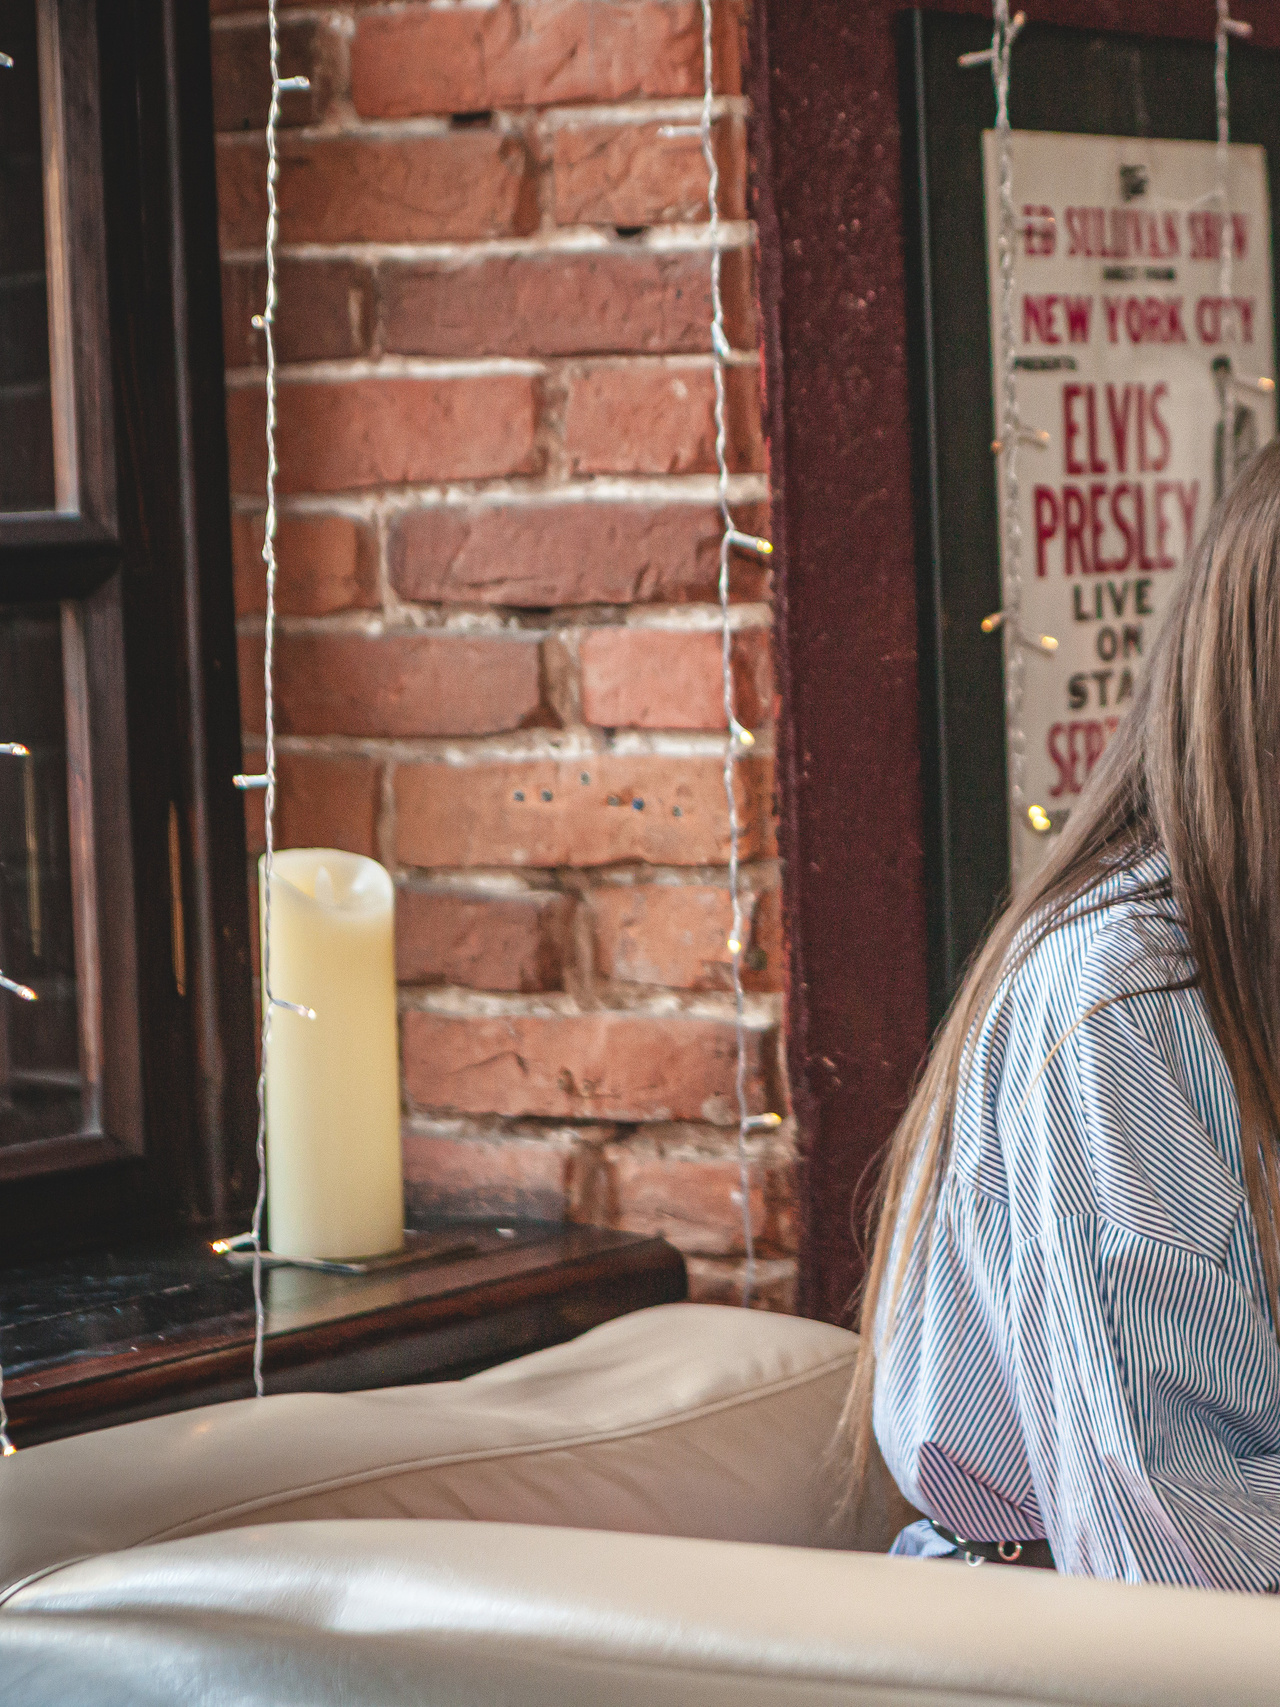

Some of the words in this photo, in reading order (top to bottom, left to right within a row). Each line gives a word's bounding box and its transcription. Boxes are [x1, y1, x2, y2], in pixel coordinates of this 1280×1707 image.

[1064, 206, 1180, 260] SULLIVAN
[1022, 294, 1093, 344] NEW
[1101, 296, 1187, 344] YORK
[1062, 381, 1170, 474] ELVIS
[1034, 480, 1200, 578] PRESLEY
[1073, 579, 1153, 622] LIVE
[1096, 624, 1142, 661] ON
[1068, 669, 1136, 709] STA
